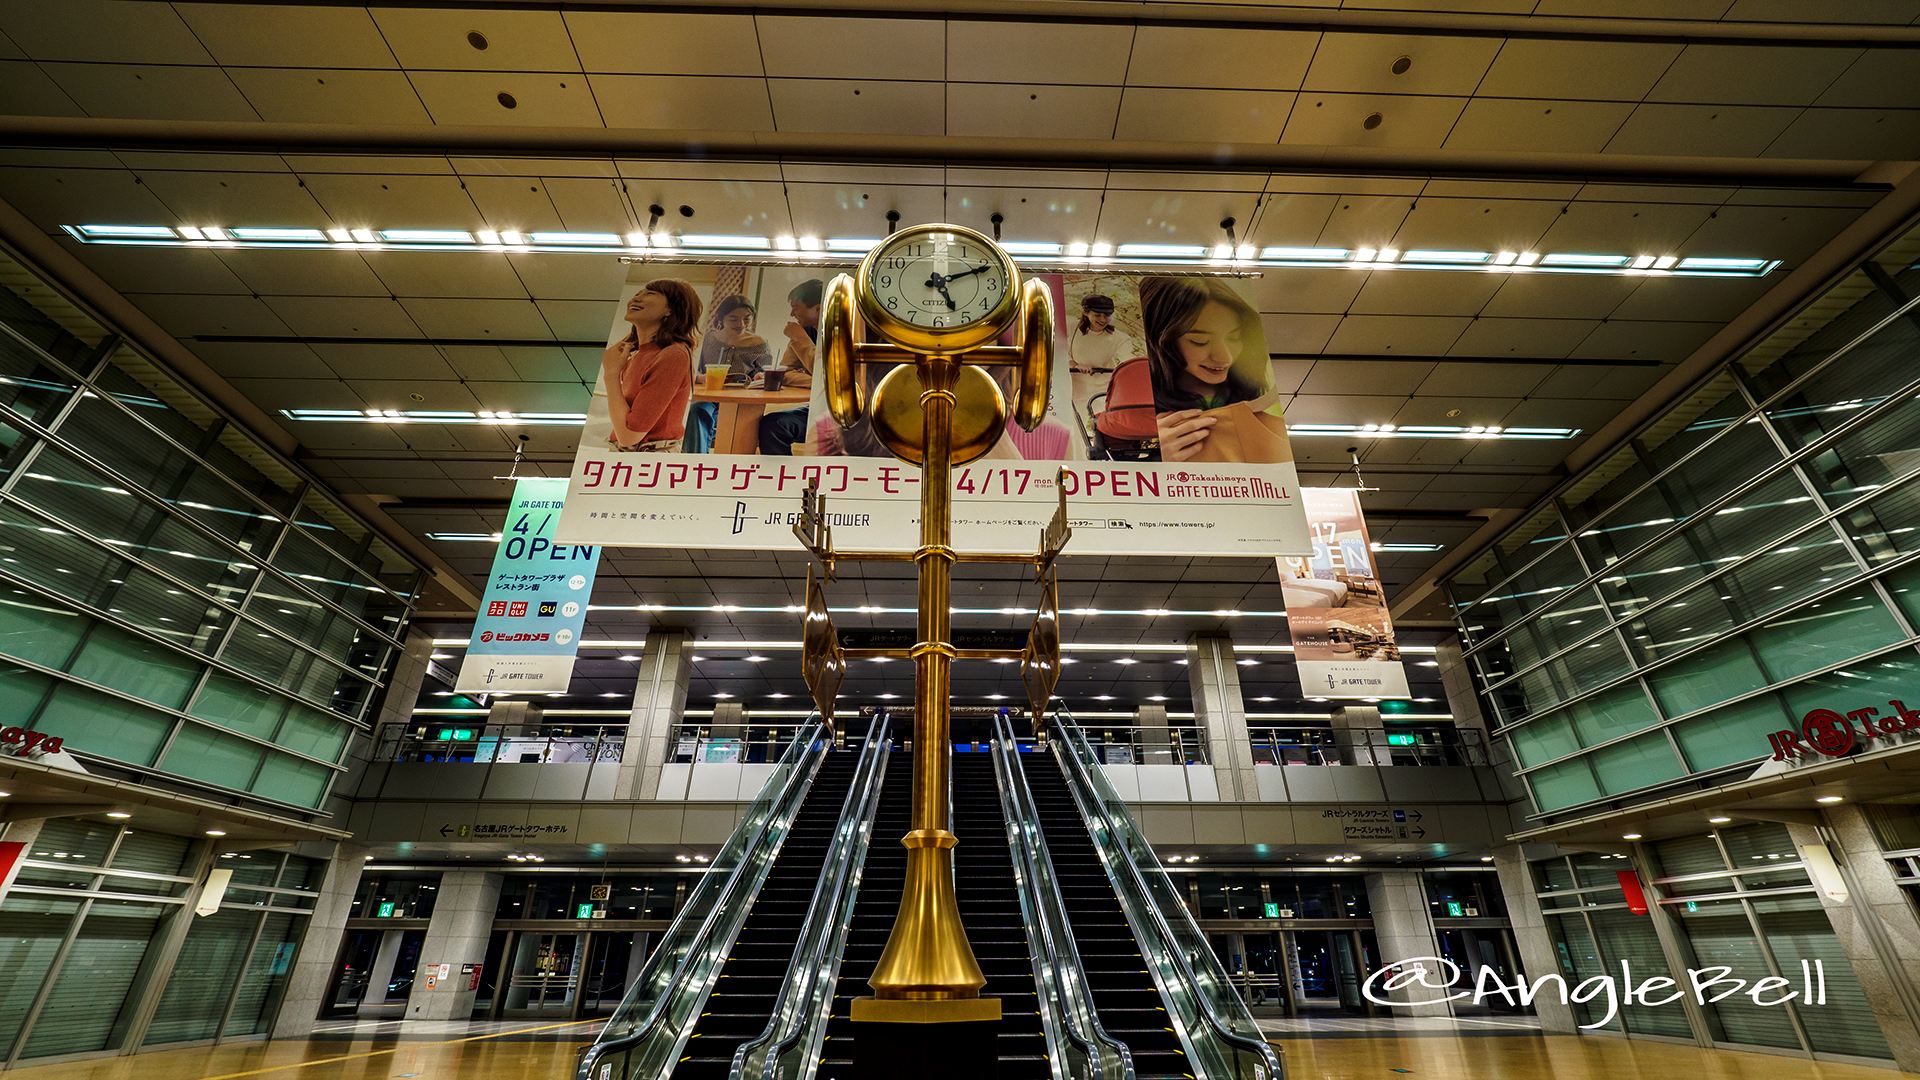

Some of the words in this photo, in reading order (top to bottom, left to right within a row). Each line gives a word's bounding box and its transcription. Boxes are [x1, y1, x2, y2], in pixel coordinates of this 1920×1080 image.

[907, 245, 922, 257] 11
[961, 246, 968, 258] 1
[887, 257, 907, 270] 10
[881, 276, 892, 289] 9
[987, 278, 997, 291] 3
[887, 297, 898, 310] 8
[979, 297, 990, 310] 4
[907, 311, 917, 323] 7
[933, 316, 944, 328] 6
[961, 312, 971, 324] 5
[583, 461, 719, 489] タカシマヤ
[956, 469, 1031, 495] 4/17
[1190, 474, 1246, 483] Takashimaya
[518, 501, 529, 509] JR
[530, 501, 550, 509] GATE
[765, 513, 782, 525] JR
[826, 513, 870, 526] TOWER
[1312, 522, 1336, 544] 17
[505, 537, 594, 560] OPEN
[496, 583, 541, 591] レストラン街
[540, 605, 556, 613] GU
[495, 632, 550, 642] ビックカメラ
[0, 725, 64, 756] aya
[1767, 729, 1808, 761] JR
[1322, 810, 1389, 818] JRセントラルタワーズ
[474, 824, 567, 833] 名古屋JRゲートタワーホテル
[1344, 826, 1392, 834] タワーズシャトル
